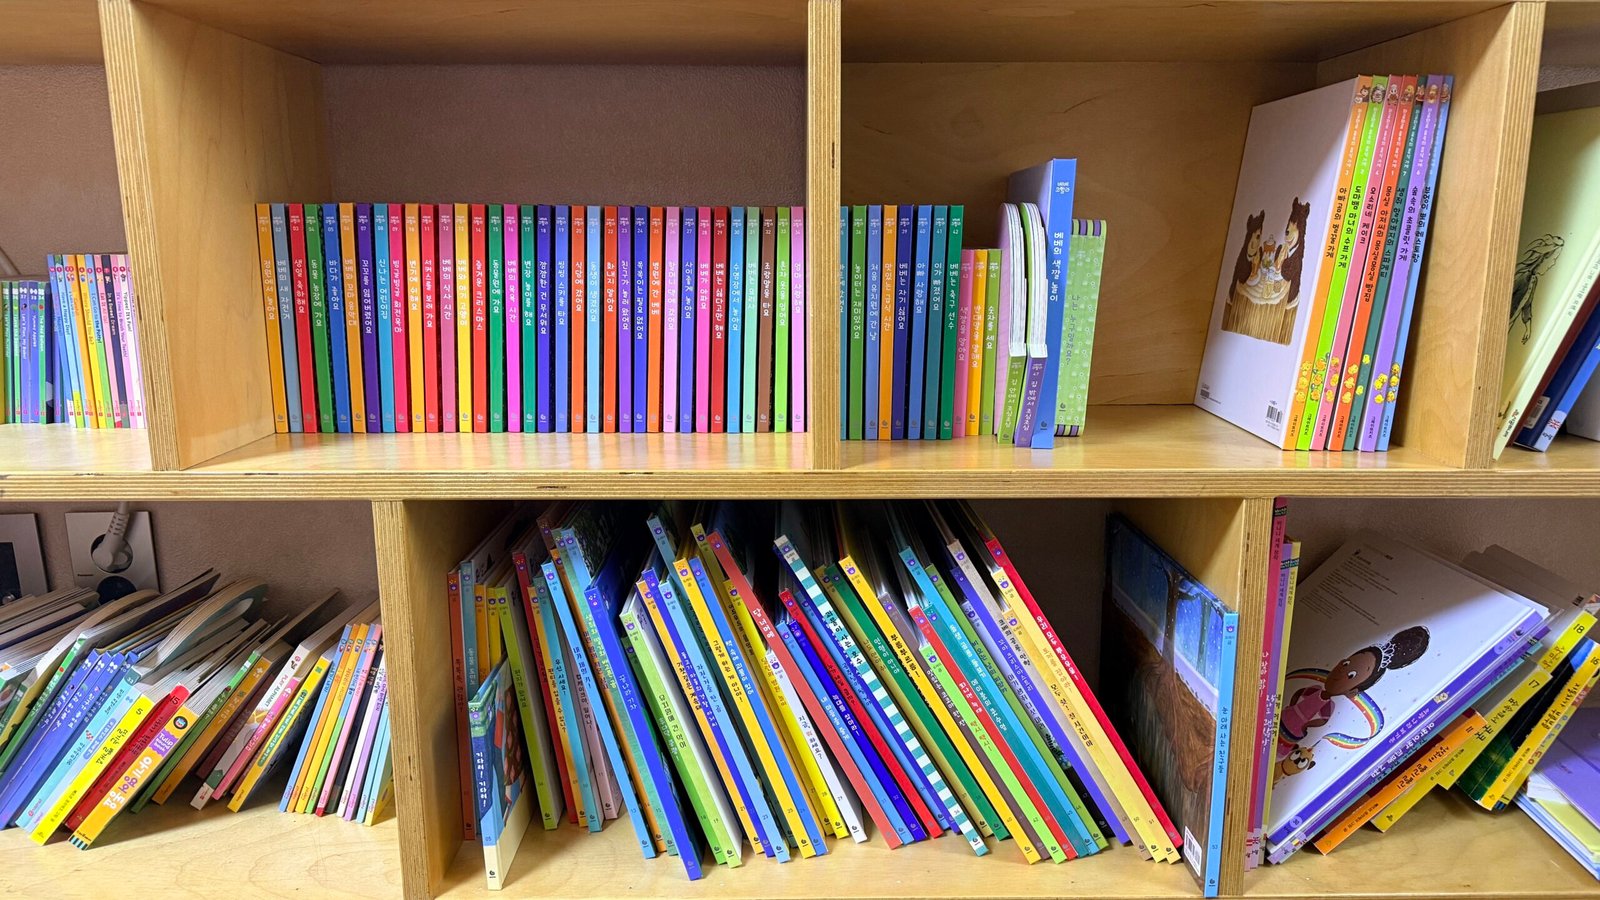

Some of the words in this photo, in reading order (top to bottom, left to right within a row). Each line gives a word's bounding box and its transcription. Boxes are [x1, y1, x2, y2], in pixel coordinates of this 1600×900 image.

[1337, 186, 1347, 201] 아빠
[1351, 185, 1363, 210] 도마뱀
[1364, 186, 1377, 217] 오소리네
[1420, 186, 1432, 210] 부엉이
[1333, 201, 1343, 220] 곰의
[1345, 212, 1357, 235] 마녀의
[1375, 209, 1388, 237] 아저씨의
[1386, 207, 1401, 246] 할아버지의
[1402, 216, 1413, 245] 초콜릿
[1327, 222, 1339, 244] 벌꿀
[1359, 222, 1370, 245] 케이크
[1054, 232, 1063, 255] 베베의
[1324, 244, 1334, 258] 가게
[1341, 236, 1351, 252] 수프
[1410, 230, 1423, 263] 레스토랑
[1338, 253, 1347, 268] 가게
[1378, 248, 1392, 277] 스파게티
[1398, 247, 1408, 261] 가게
[278, 260, 286, 280] 베베의
[295, 260, 302, 277] 생일
[312, 260, 317, 280] 동물
[329, 260, 338, 281] 바다가
[443, 260, 451, 279] 베베의
[492, 260, 500, 294] 동물원에
[508, 261, 516, 280] 베베의
[525, 261, 532, 278] 변장
[575, 262, 583, 284] 식당에
[685, 263, 693, 291] 사이좋게
[700, 264, 708, 283] 베베가
[716, 263, 724, 284] 베베는
[871, 264, 877, 279] 처음
[899, 264, 907, 285] 베베는
[917, 264, 925, 276] 아빠
[934, 264, 942, 275] 이가
[950, 264, 958, 286] 베베는
[1051, 260, 1061, 279] 색깔
[732, 264, 740, 303] 수영장에서
[763, 263, 771, 298] 조랑말을
[313, 284, 321, 307] 농장에
[331, 287, 339, 310] 좋아요
[443, 285, 451, 299] 식사
[510, 285, 515, 301] 목욕
[623, 290, 629, 304] 놀러
[700, 290, 708, 309] 아파요
[870, 284, 878, 316] 유치원에
[899, 291, 906, 303] 자기
[916, 283, 924, 313] 사랑해요
[933, 280, 941, 310] 빠졌어요
[950, 290, 956, 308] 축구
[1050, 282, 1059, 302] 놀이
[1362, 282, 1373, 303] 빵집
[281, 298, 290, 319] 자전거
[426, 296, 432, 308] 보러
[493, 301, 500, 313] 가요
[652, 303, 659, 314] 베베
[763, 304, 771, 316] 타요
[1072, 295, 1080, 311] 나는
[315, 313, 322, 326] 가요
[394, 301, 402, 332] 회전목마
[427, 314, 433, 327] 가요
[444, 305, 451, 320] 시간
[509, 308, 516, 322] 시간
[525, 311, 532, 325] 해요
[948, 313, 955, 329] 선수
[715, 325, 723, 338] 해요
[870, 332, 876, 340] 날
[986, 335, 994, 349] 세요
[1027, 390, 1036, 405] 밖에서
[1023, 409, 1031, 431] 조심조심
[1572, 622, 1585, 634] 18
[572, 645, 583, 659] 내가
[1589, 655, 1600, 666] 16
[1528, 678, 1538, 689] 17
[168, 694, 180, 706] 15
[134, 707, 143, 715] 5
